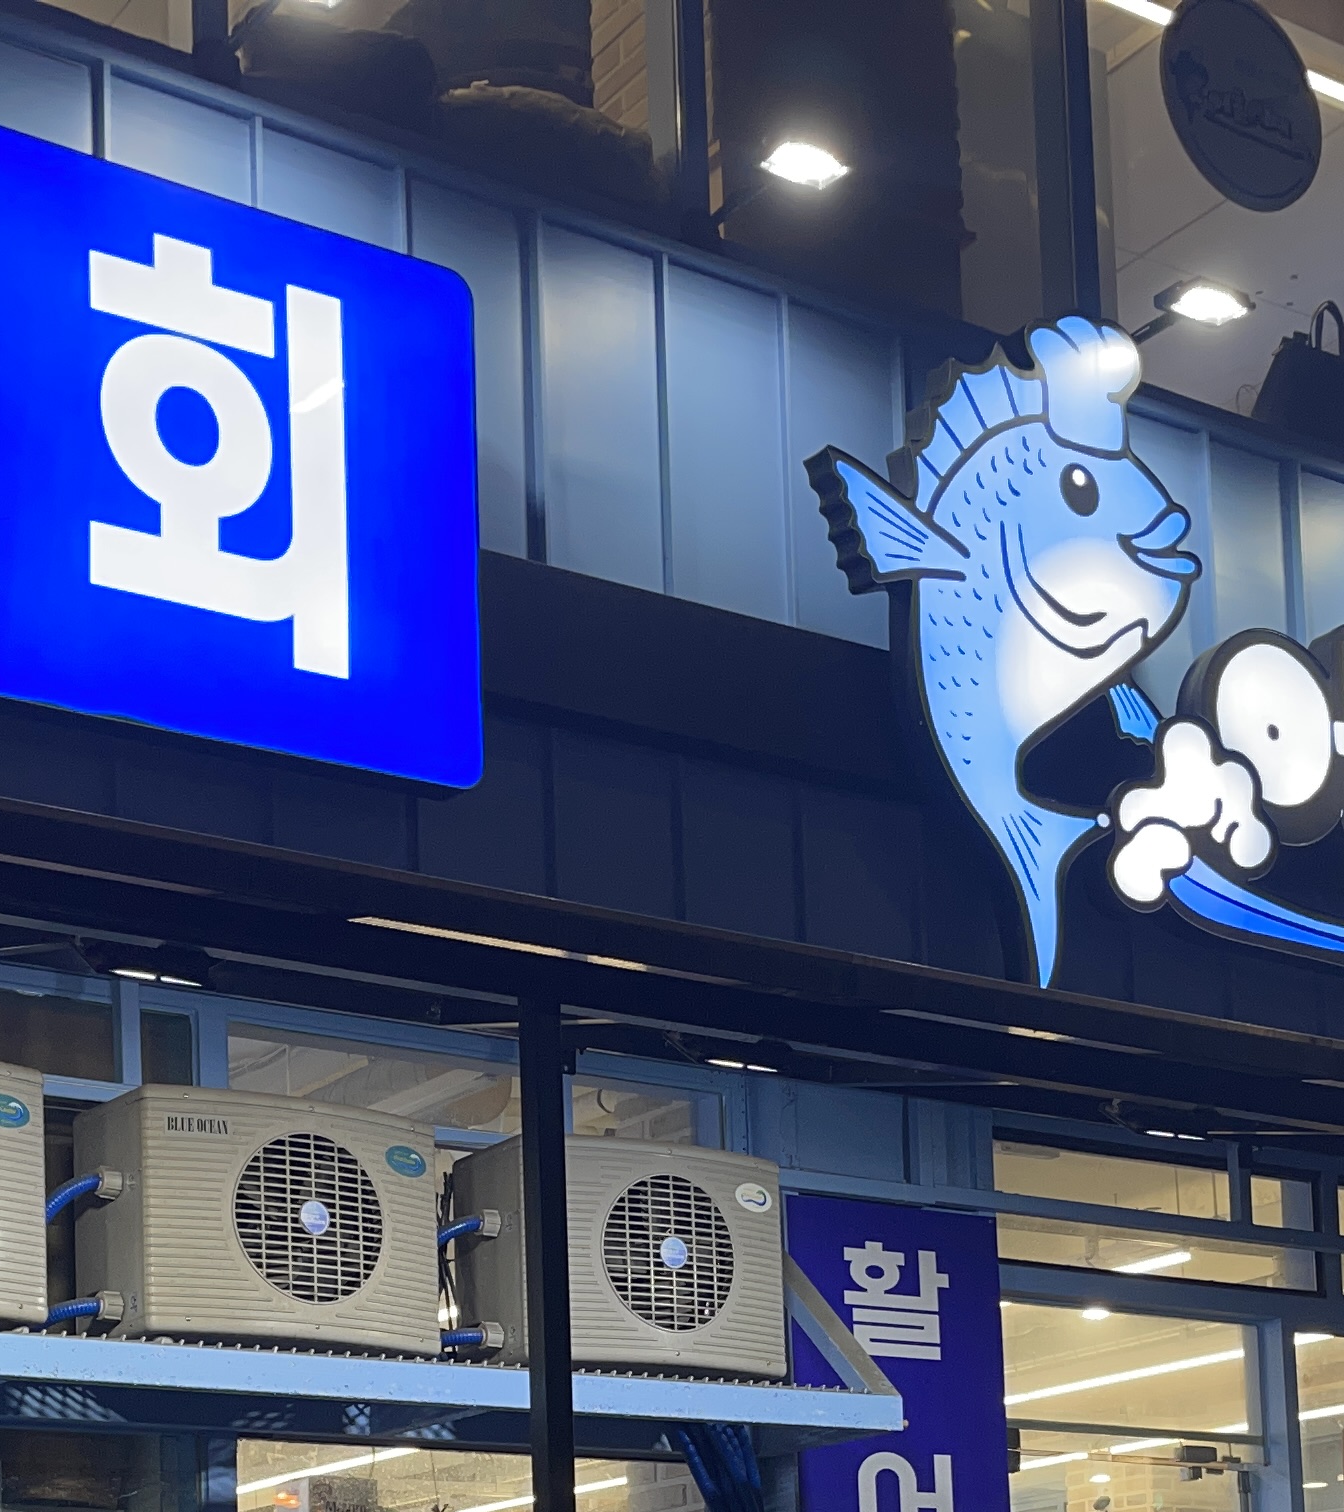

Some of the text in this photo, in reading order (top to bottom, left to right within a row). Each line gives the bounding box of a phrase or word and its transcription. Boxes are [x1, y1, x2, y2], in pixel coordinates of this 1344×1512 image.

[88, 231, 351, 680] 회
[167, 1116, 229, 1136] BLUE OCEAN
